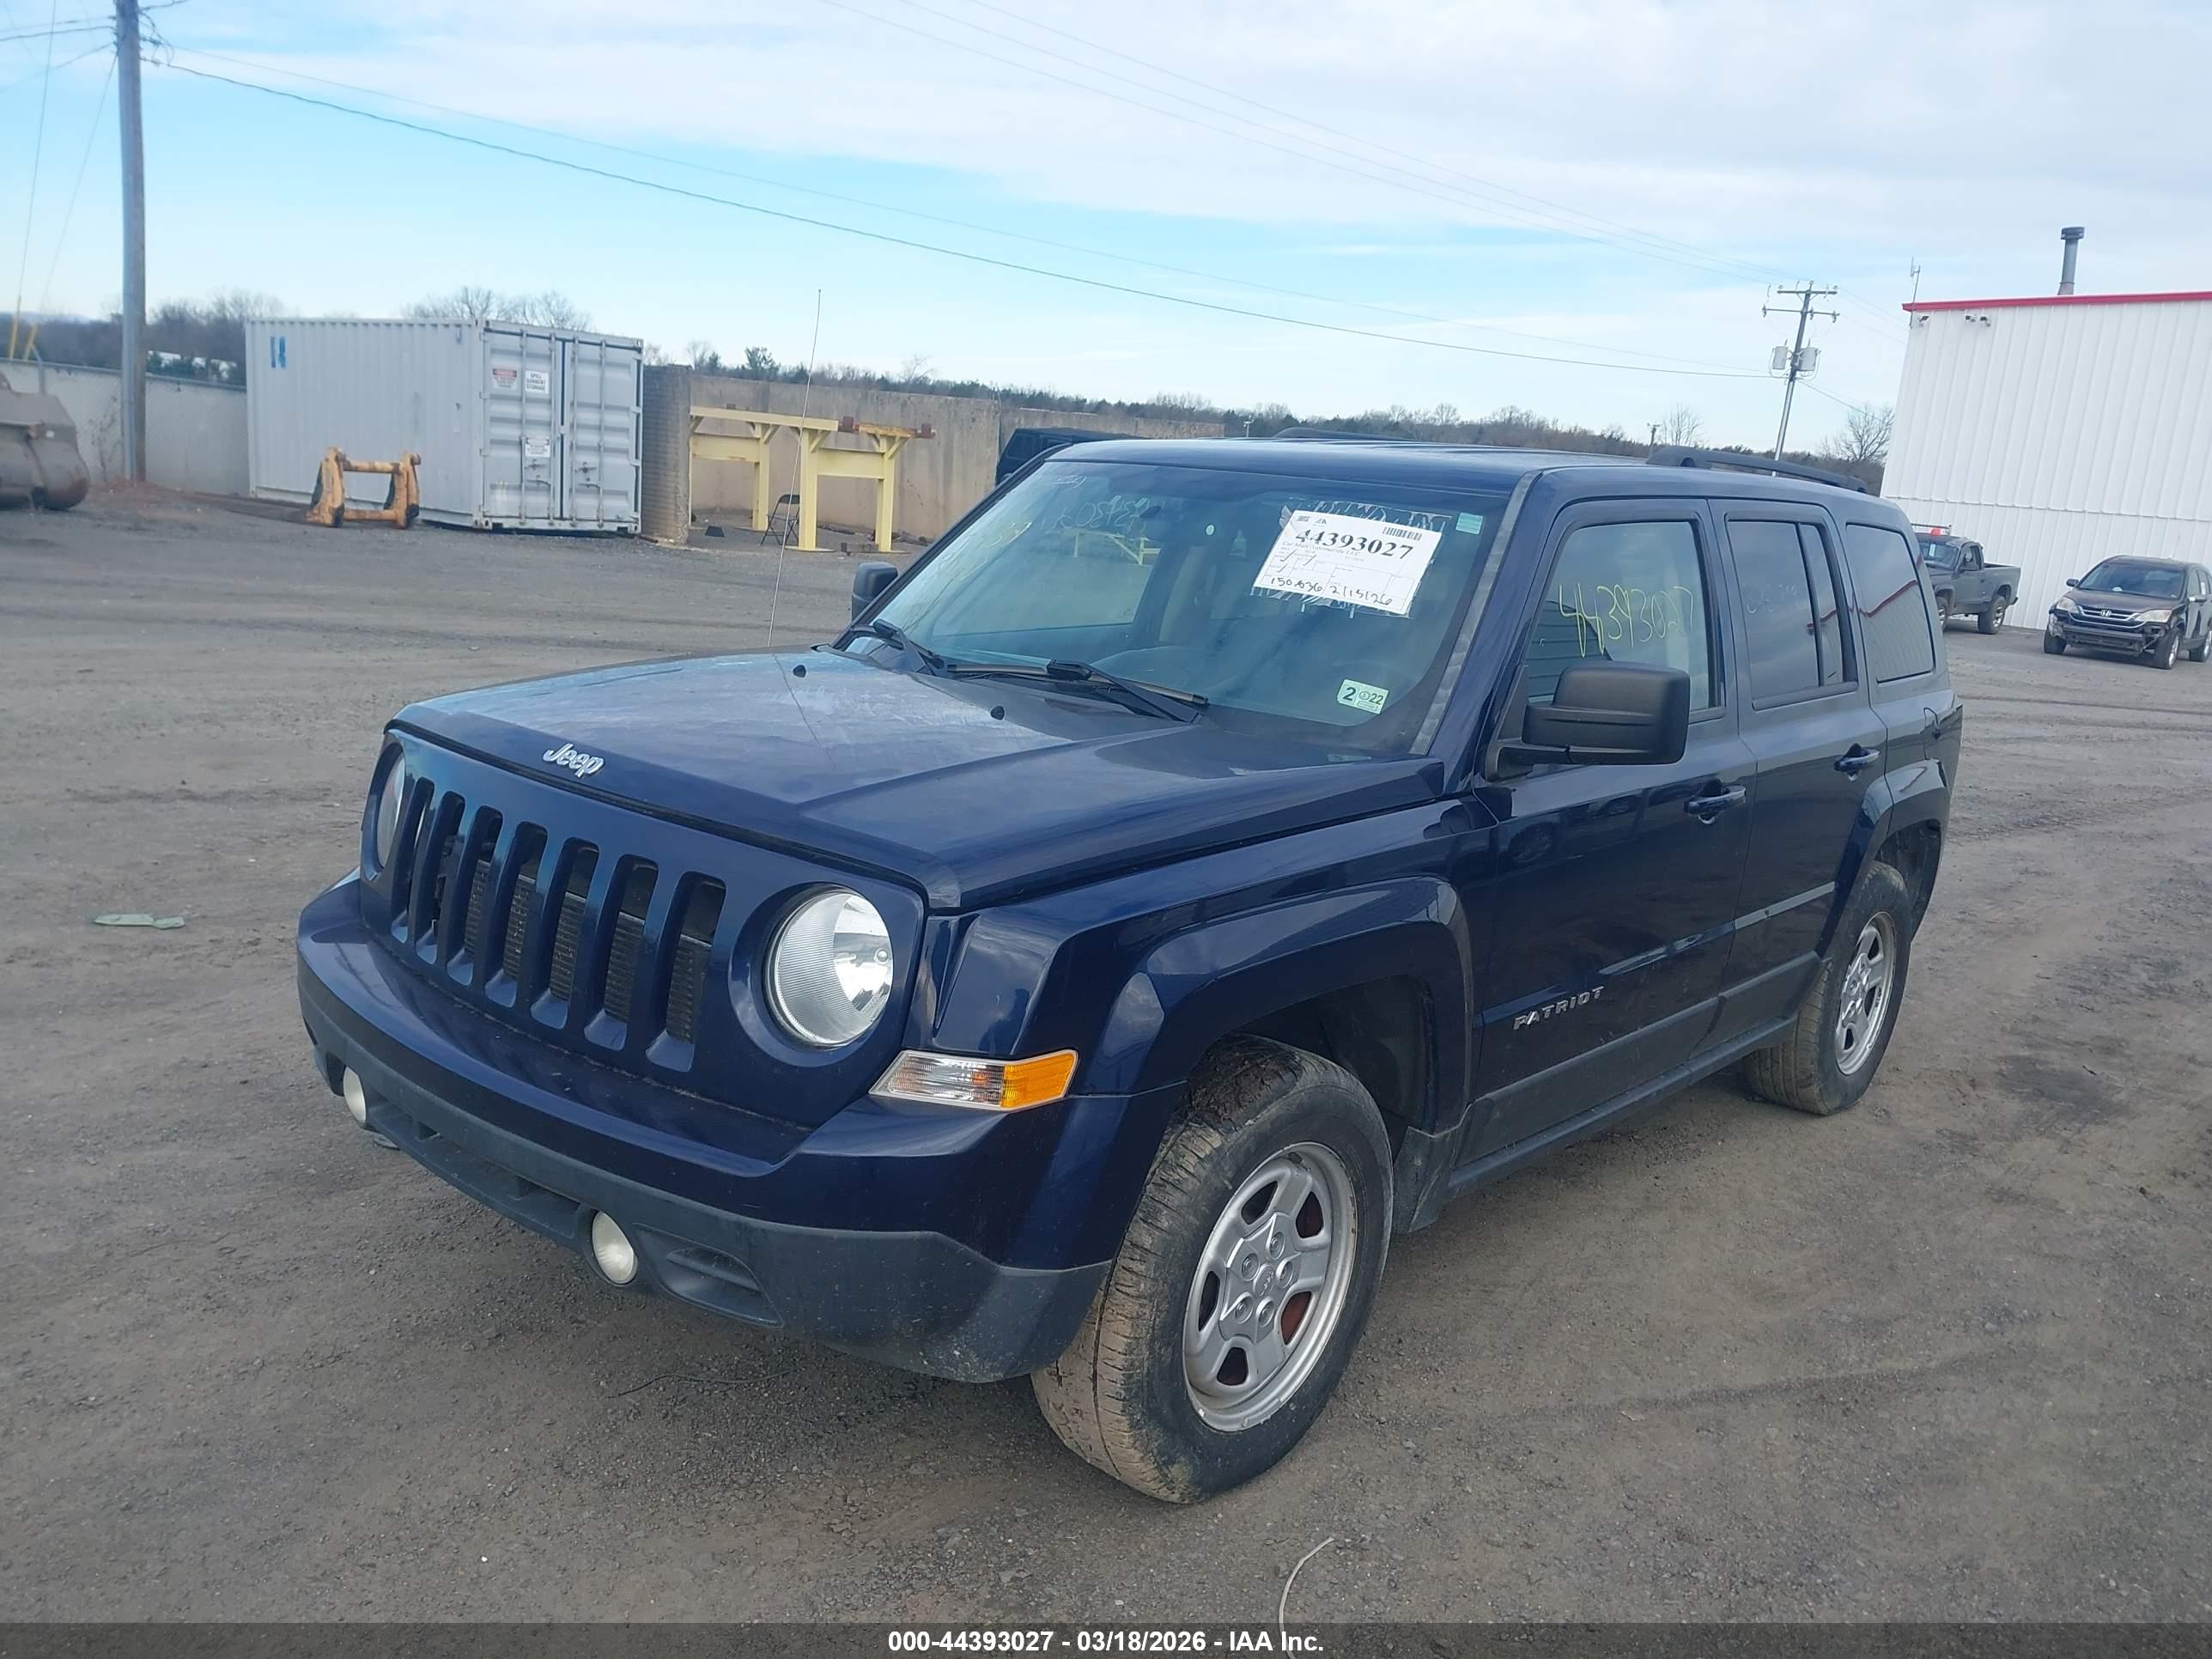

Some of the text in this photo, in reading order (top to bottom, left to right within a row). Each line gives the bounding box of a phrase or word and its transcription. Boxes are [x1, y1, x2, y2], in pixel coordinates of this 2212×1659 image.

[1295, 529, 1413, 560] 44393027
[1342, 687, 1356, 701] 2
[1369, 693, 1383, 705] 22
[543, 743, 605, 778] Jeep
[1513, 986, 1605, 1030] PATRIOT
